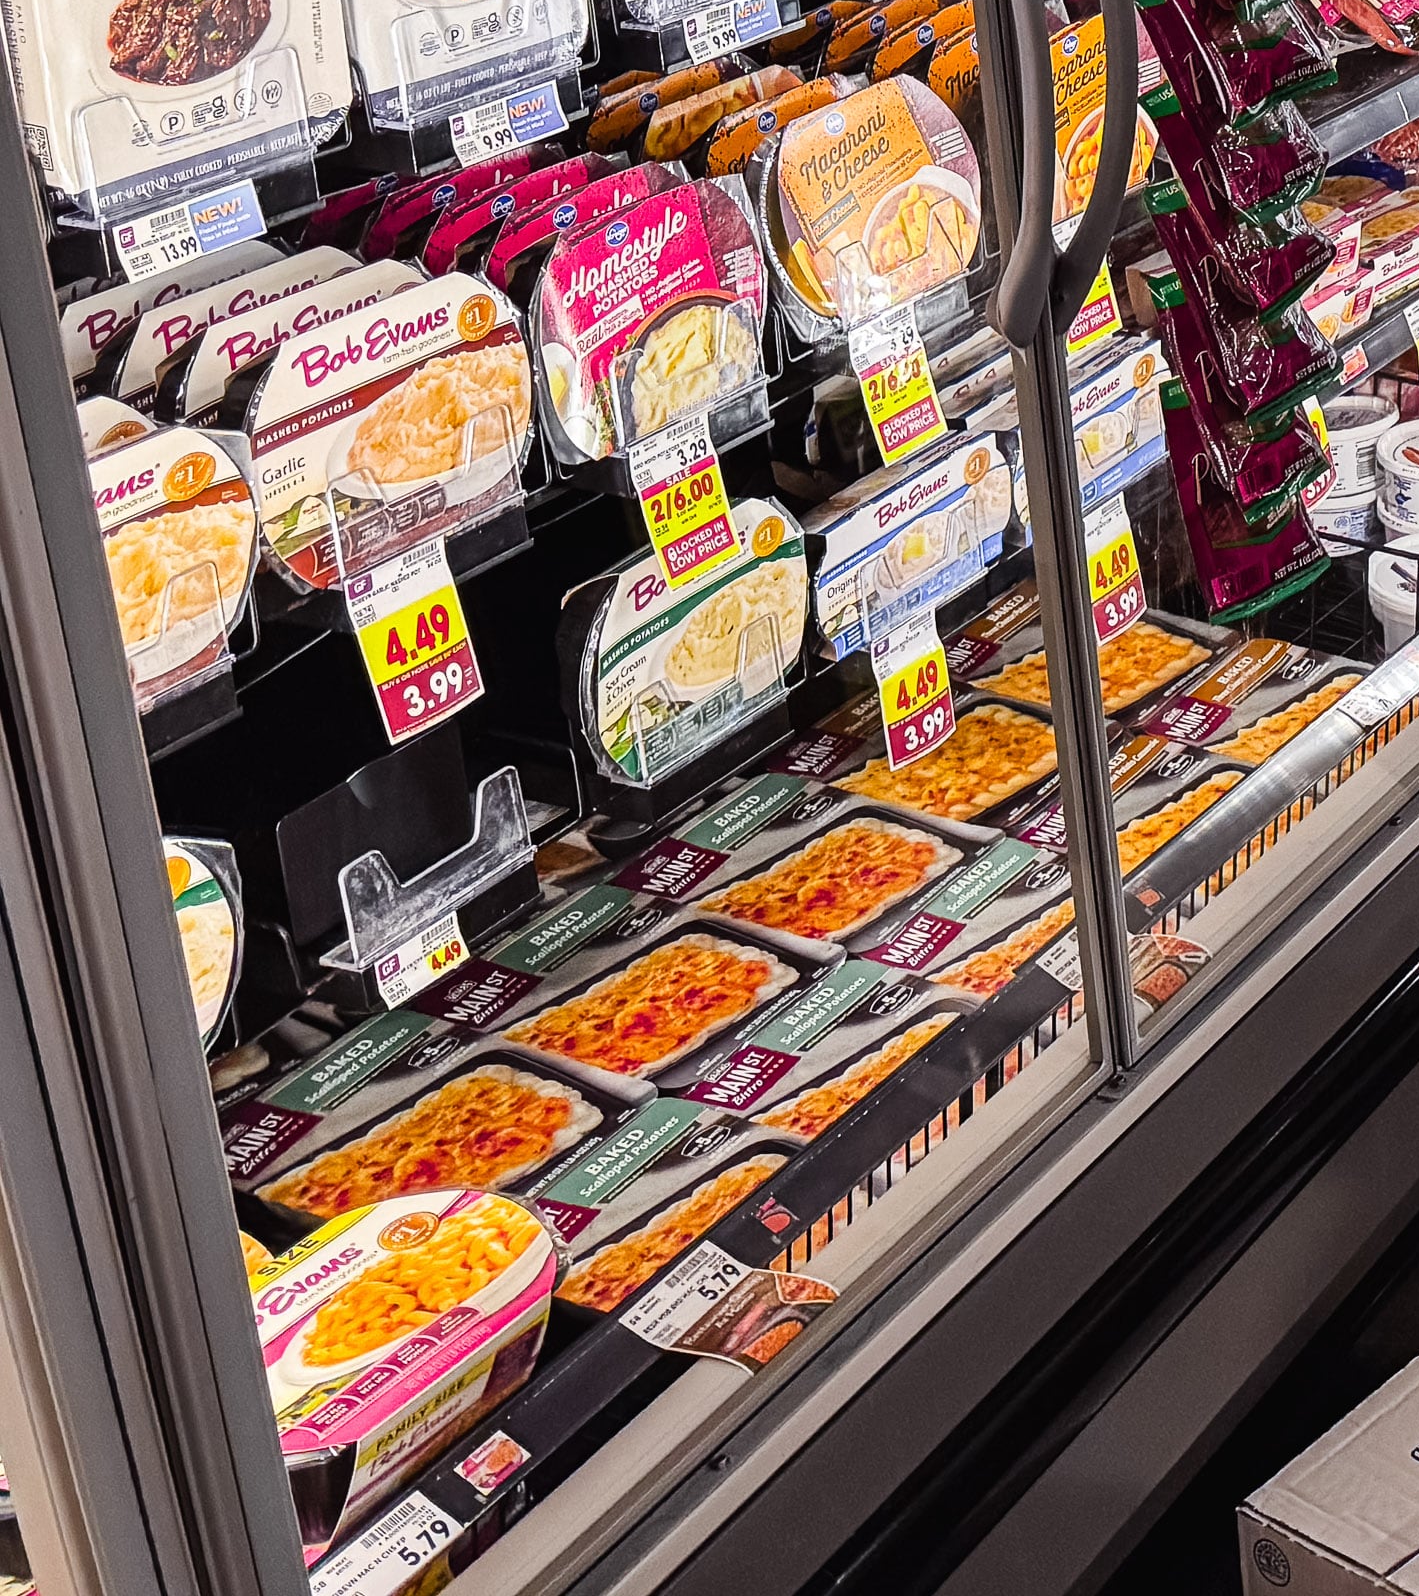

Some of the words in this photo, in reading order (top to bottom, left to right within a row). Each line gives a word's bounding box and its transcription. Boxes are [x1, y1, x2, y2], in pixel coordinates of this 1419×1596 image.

[799, 105, 887, 186] Macaroni
[832, 136, 891, 193] Cheese
[192, 196, 245, 226] NEW!
[160, 236, 198, 265] 13.99
[562, 206, 688, 306] Homestyle
[591, 263, 660, 319] POTATOES
[592, 256, 651, 303] MASHED
[291, 334, 359, 389] Bob
[361, 302, 451, 361] Evans
[255, 421, 300, 450] MASHED
[300, 397, 355, 430] POTATOES
[261, 454, 307, 486] Garlic
[665, 467, 692, 488] SALE
[678, 439, 708, 467] 3.29
[650, 472, 714, 524] 2/6.00
[670, 551, 697, 573] LOW
[697, 531, 730, 560] PRICE
[676, 524, 714, 556] LOCKED
[713, 520, 725, 534] IN
[1094, 550, 1130, 589] 4.49
[1104, 587, 1139, 627] 3.99
[385, 604, 451, 667] 4.49
[402, 661, 464, 718] 3.99
[896, 660, 939, 711] 4.49
[903, 706, 945, 752] 3.99
[715, 792, 762, 829] BAKED
[443, 986, 487, 1023] MAIN
[486, 970, 509, 996] ST
[304, 1059, 364, 1107] Scalloped
[360, 1024, 410, 1069] Potatoes
[310, 1037, 375, 1086] BAKED
[708, 1064, 744, 1102] MAIN
[741, 1049, 766, 1077] ST
[584, 1127, 643, 1174] BAKED
[255, 1243, 365, 1316] Evans
[256, 1236, 320, 1278] SIZE
[696, 1262, 741, 1302] 5.79
[375, 1400, 430, 1452] FAMILY
[433, 1376, 466, 1404] SIZE
[396, 1518, 451, 1568] 5.79
